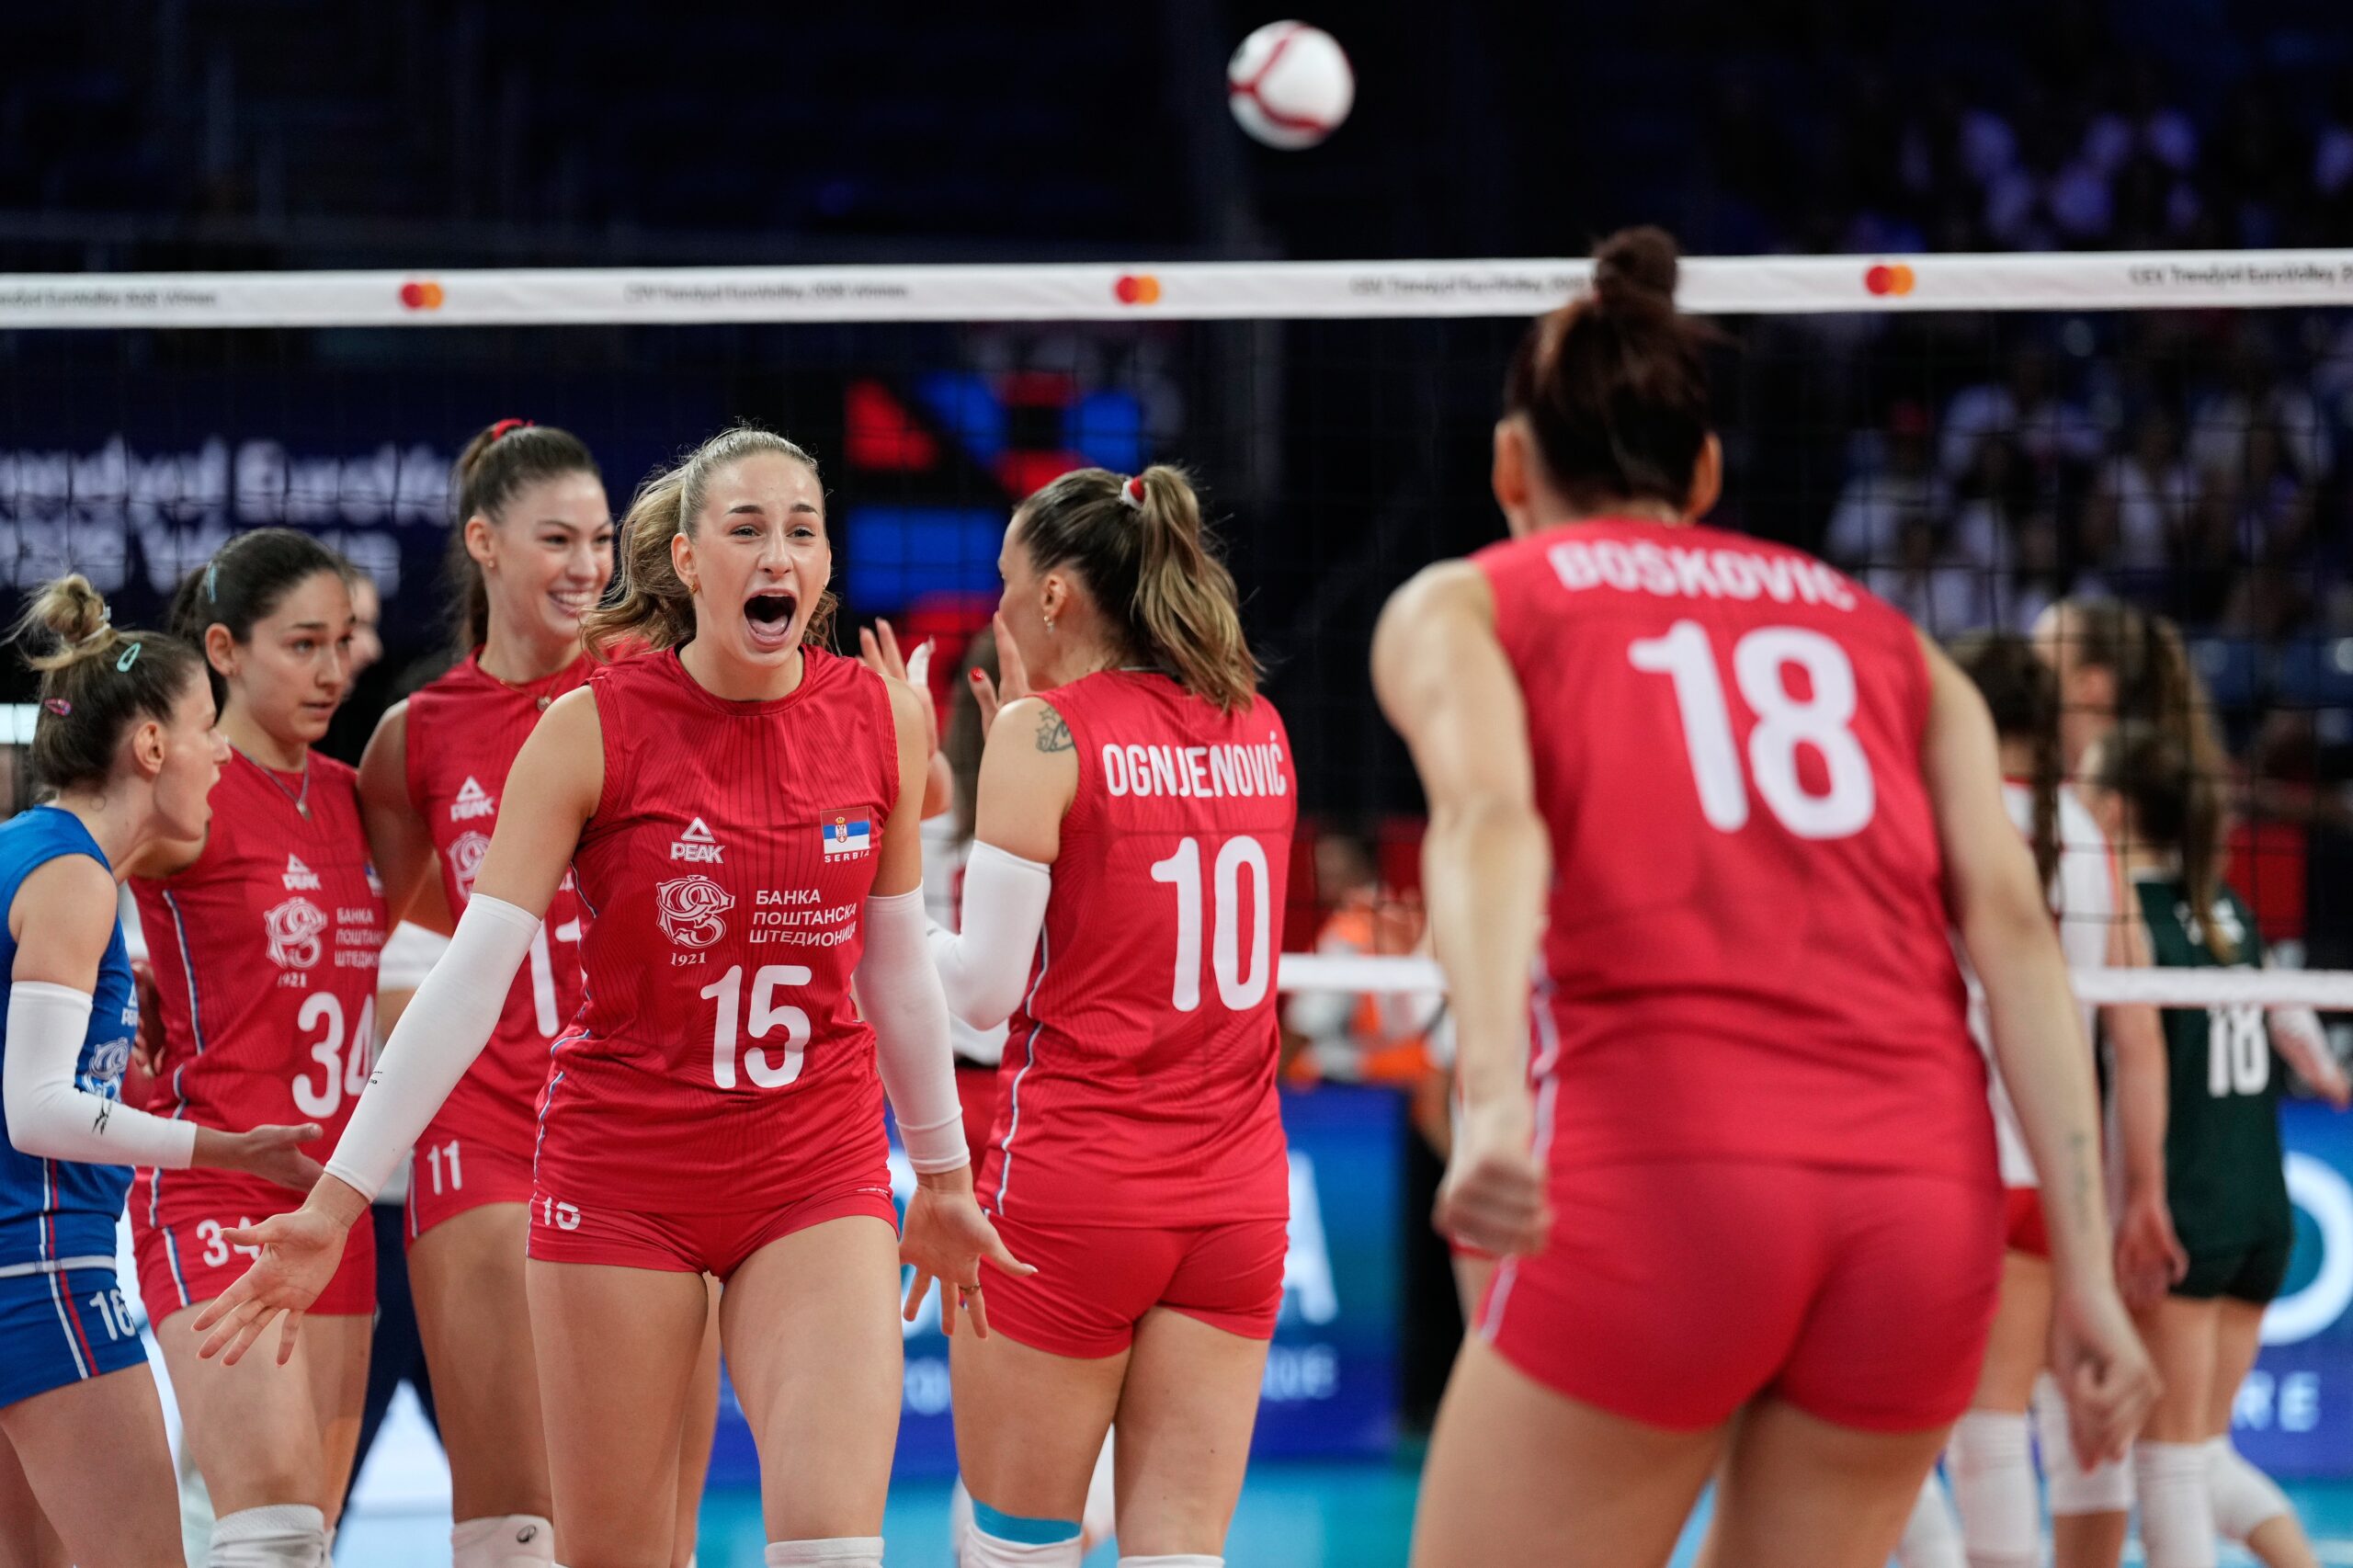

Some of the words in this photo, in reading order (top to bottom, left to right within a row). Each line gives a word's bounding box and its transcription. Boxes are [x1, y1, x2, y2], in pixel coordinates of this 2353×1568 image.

[1630, 618, 1876, 839] 18
[1103, 732, 1286, 798] OGNJENOVIĆ
[450, 797, 494, 823] PEAK
[671, 842, 725, 864] PEAK
[824, 850, 870, 863] SERBIA
[753, 903, 857, 926] ПОШТАНСКА
[756, 889, 821, 905] БАНКА
[1151, 835, 1270, 1012] 10
[671, 951, 706, 967] 1921
[700, 965, 811, 1089] 15
[292, 991, 373, 1119] 34
[426, 1140, 462, 1196] 11
[542, 1196, 581, 1230] 15
[90, 1289, 136, 1341] 16
